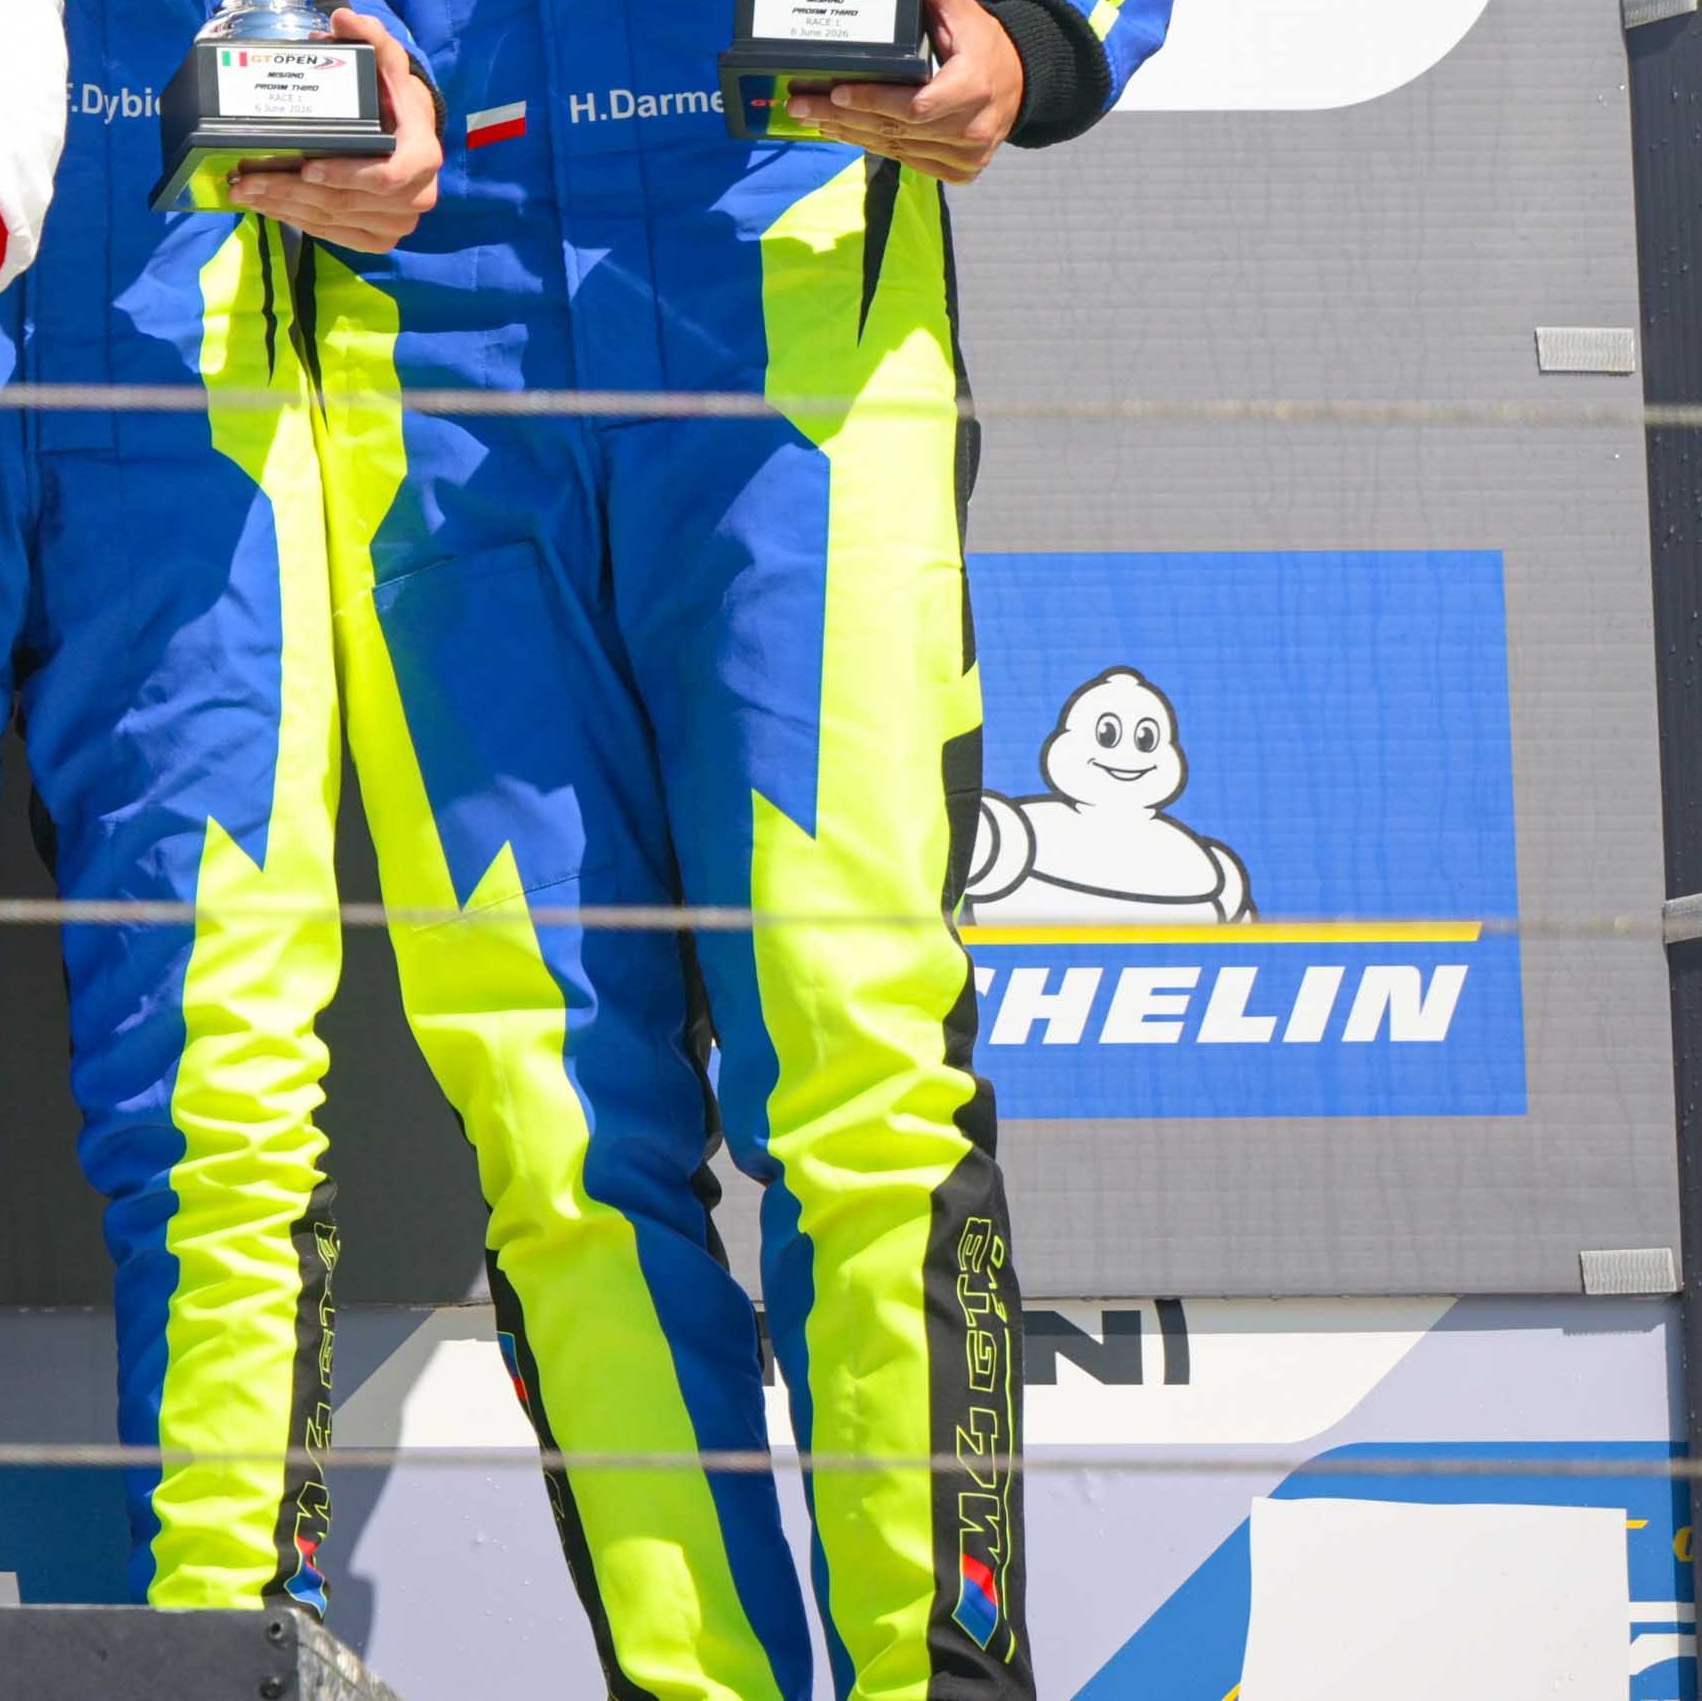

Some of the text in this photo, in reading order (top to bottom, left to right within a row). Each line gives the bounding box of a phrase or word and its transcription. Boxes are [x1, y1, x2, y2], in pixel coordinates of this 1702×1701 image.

[829, 9, 859, 17] THIRD
[806, 18, 830, 26] RACE
[799, 29, 822, 37] June
[825, 29, 849, 38] 2026
[975, 964, 1470, 1044] HELIN
